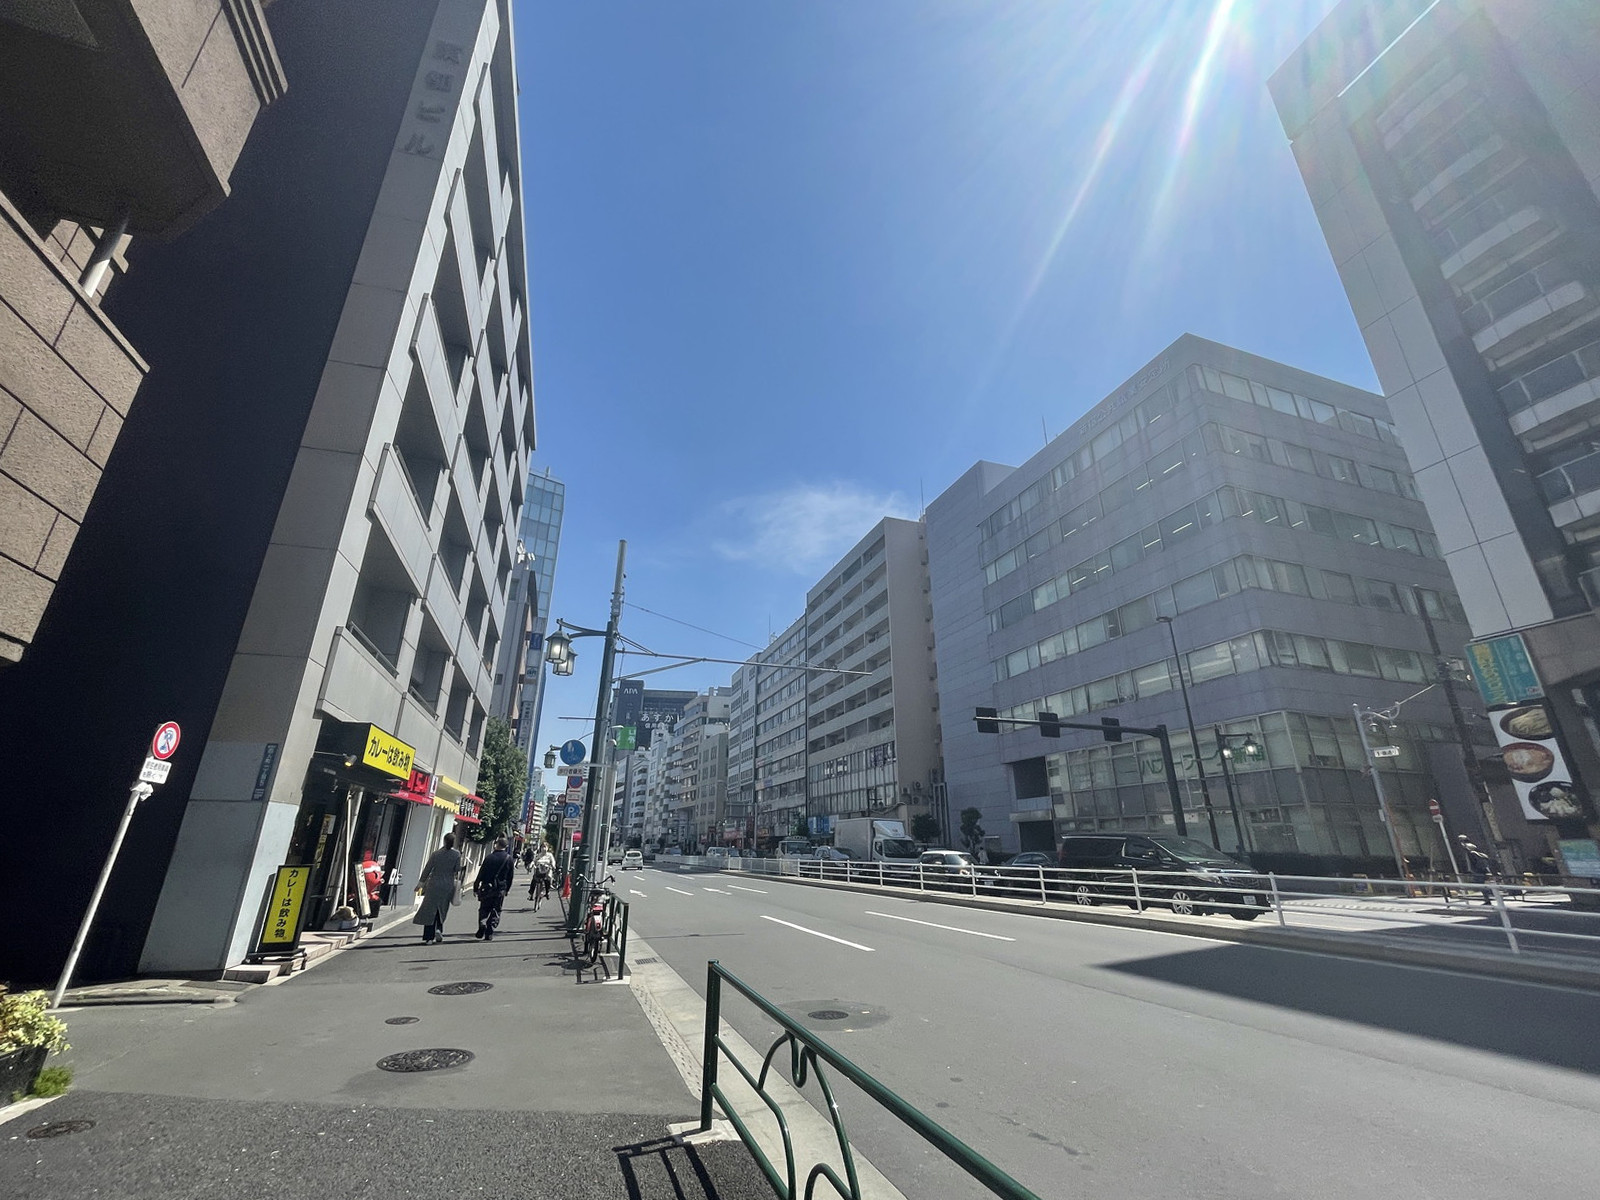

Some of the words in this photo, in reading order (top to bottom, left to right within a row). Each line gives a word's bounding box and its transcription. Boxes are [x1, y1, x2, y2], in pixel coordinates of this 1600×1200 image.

[368, 736, 411, 778] カレーは飲み物。
[274, 869, 299, 940] カレーは飲み物。
